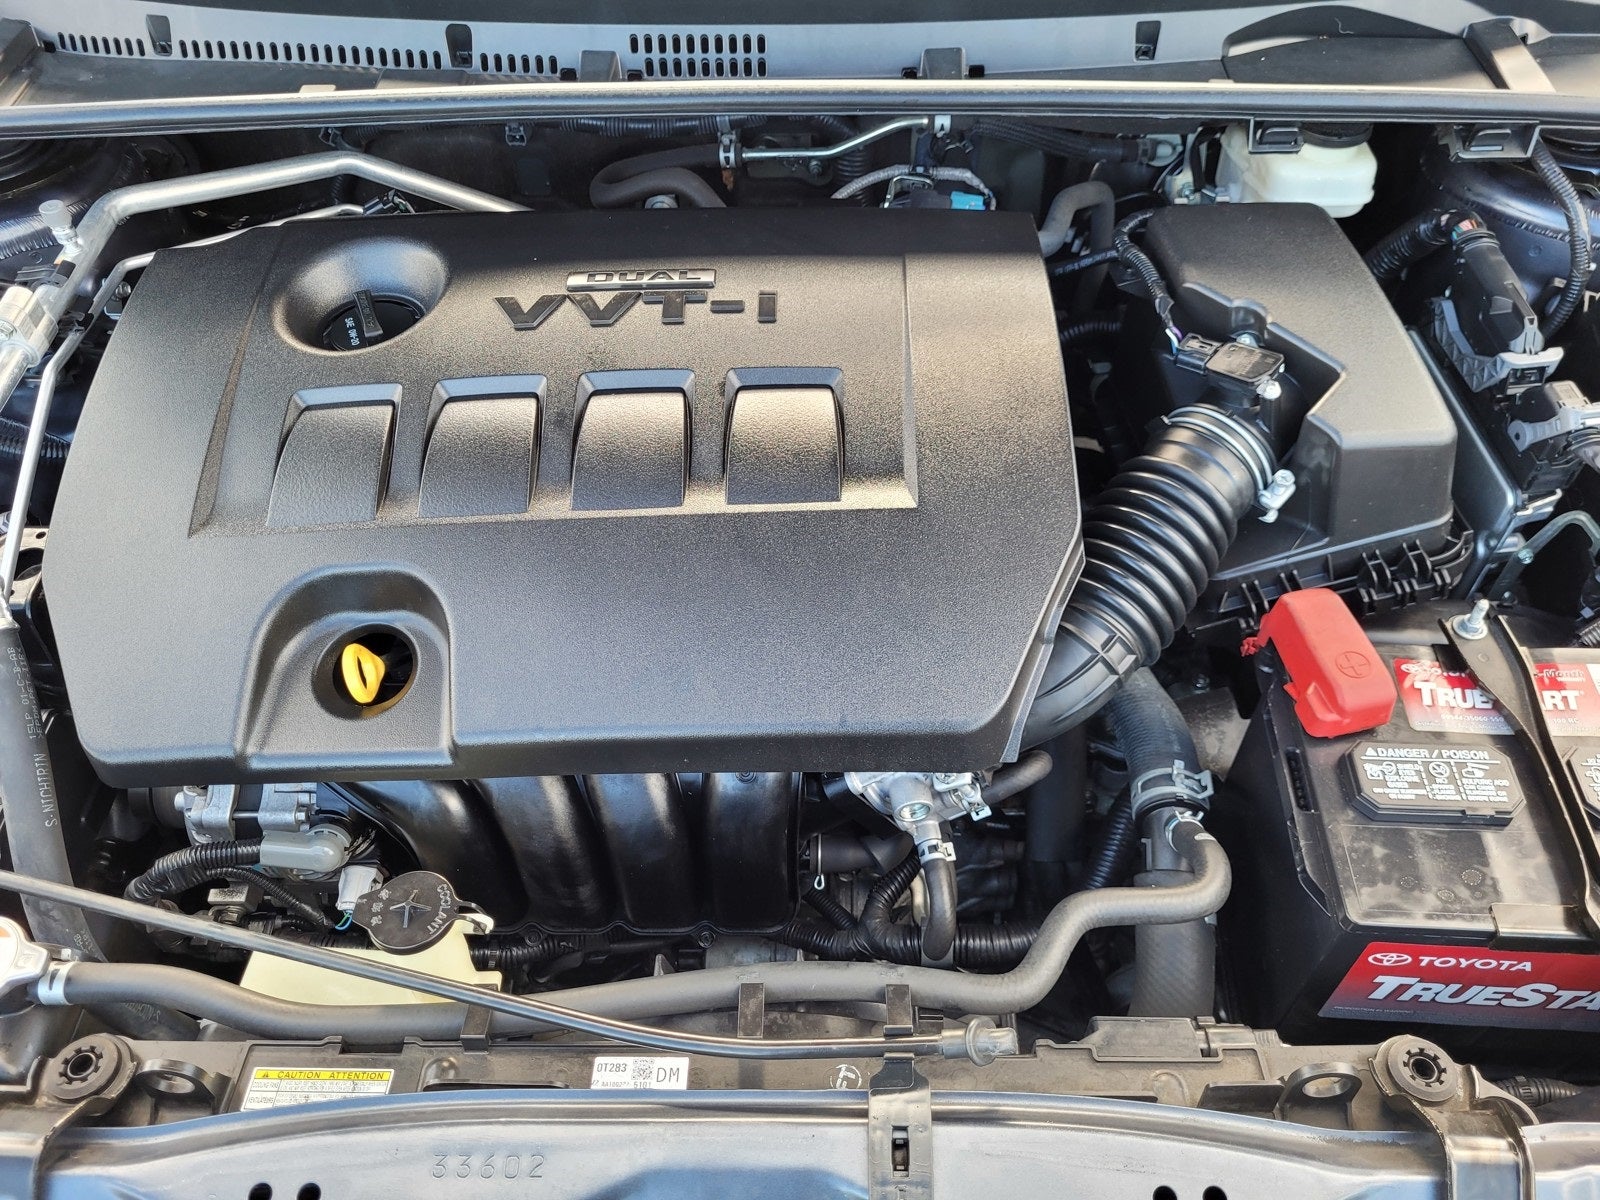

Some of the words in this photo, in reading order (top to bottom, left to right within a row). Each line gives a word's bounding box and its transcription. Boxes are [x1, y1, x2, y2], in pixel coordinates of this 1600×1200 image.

[586, 270, 702, 283] DUAL
[1377, 747, 1430, 758] DANGER
[1442, 750, 1490, 760] POISON
[427, 883, 452, 935] COOLANT
[1418, 955, 1532, 972] TOYOTA
[277, 1071, 322, 1079] CAUTION
[328, 1071, 385, 1080] ATTENTION
[656, 1067, 680, 1083] DM
[432, 1154, 545, 1179] 33602
